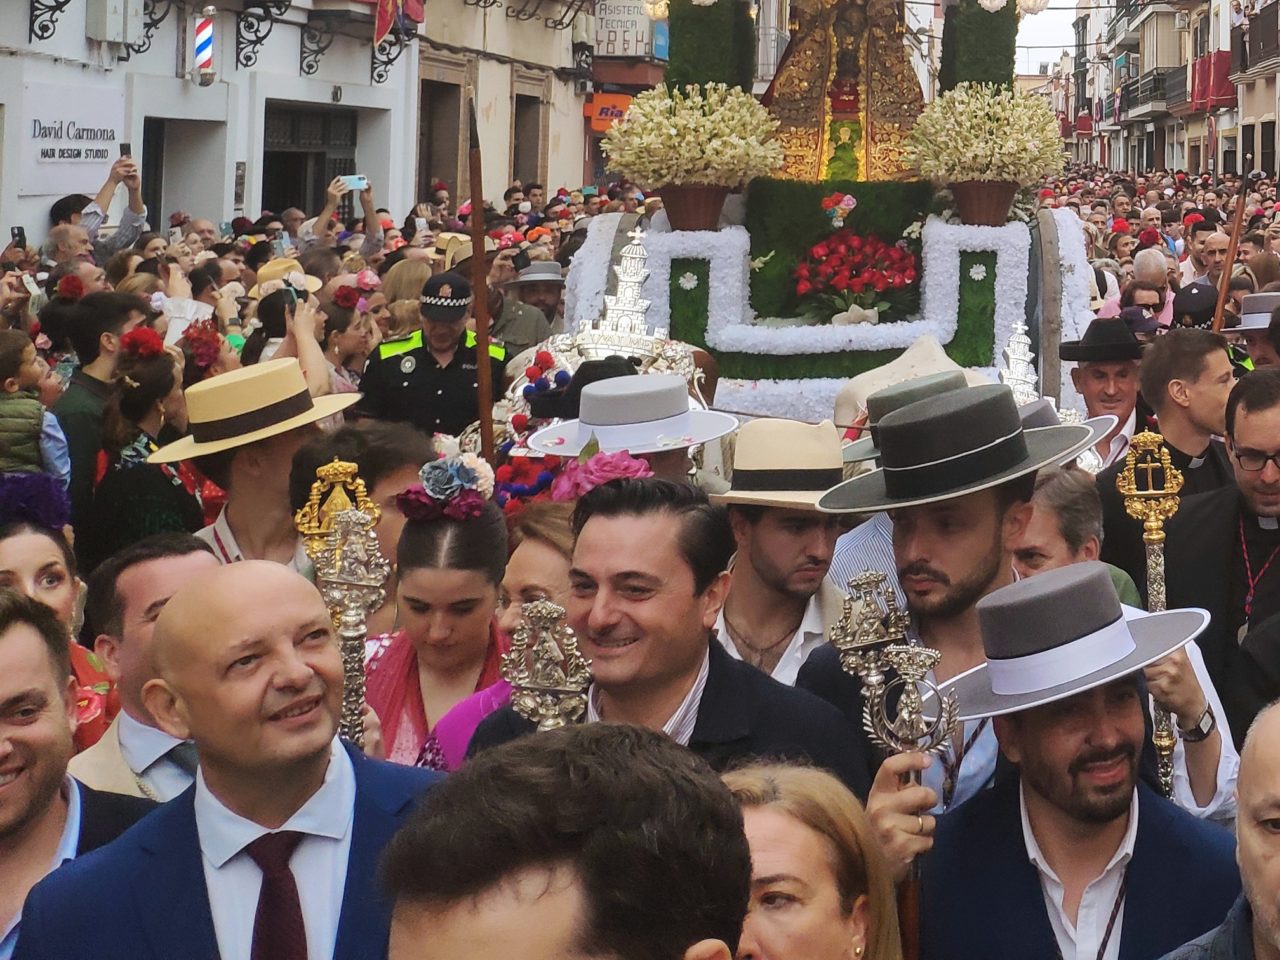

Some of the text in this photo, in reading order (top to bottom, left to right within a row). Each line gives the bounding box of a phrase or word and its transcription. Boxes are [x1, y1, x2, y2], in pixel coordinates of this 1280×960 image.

[599, 3, 645, 16] ASISTENC
[599, 18, 638, 30] TECNICA
[598, 104, 625, 118] Ria
[31, 119, 115, 141] David Carmona
[40, 148, 109, 160] HAIR DESIGN STUDIO
